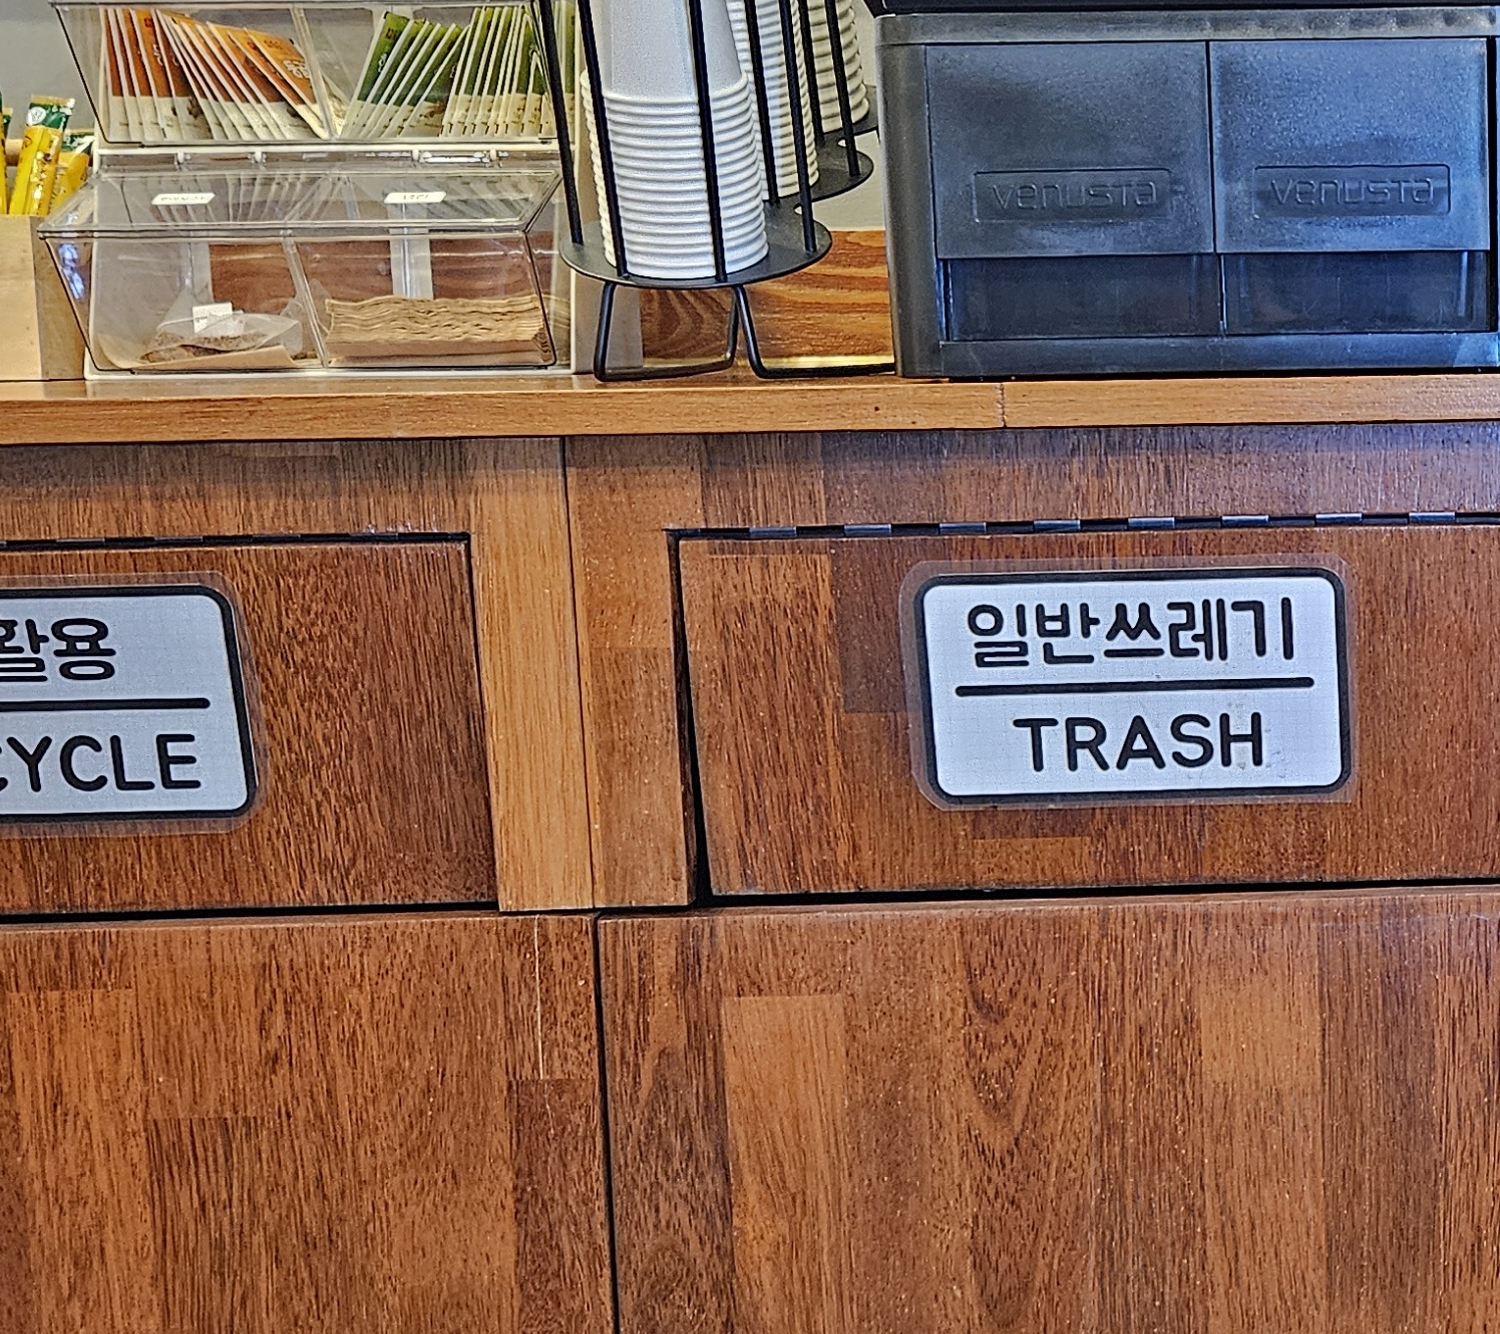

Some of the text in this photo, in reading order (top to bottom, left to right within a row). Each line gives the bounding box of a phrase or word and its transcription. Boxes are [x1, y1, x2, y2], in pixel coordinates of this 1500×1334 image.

[967, 597, 1295, 668] 일반쓰레기
[0, 733, 202, 792] YCLE
[1013, 712, 1263, 772] TRASH
